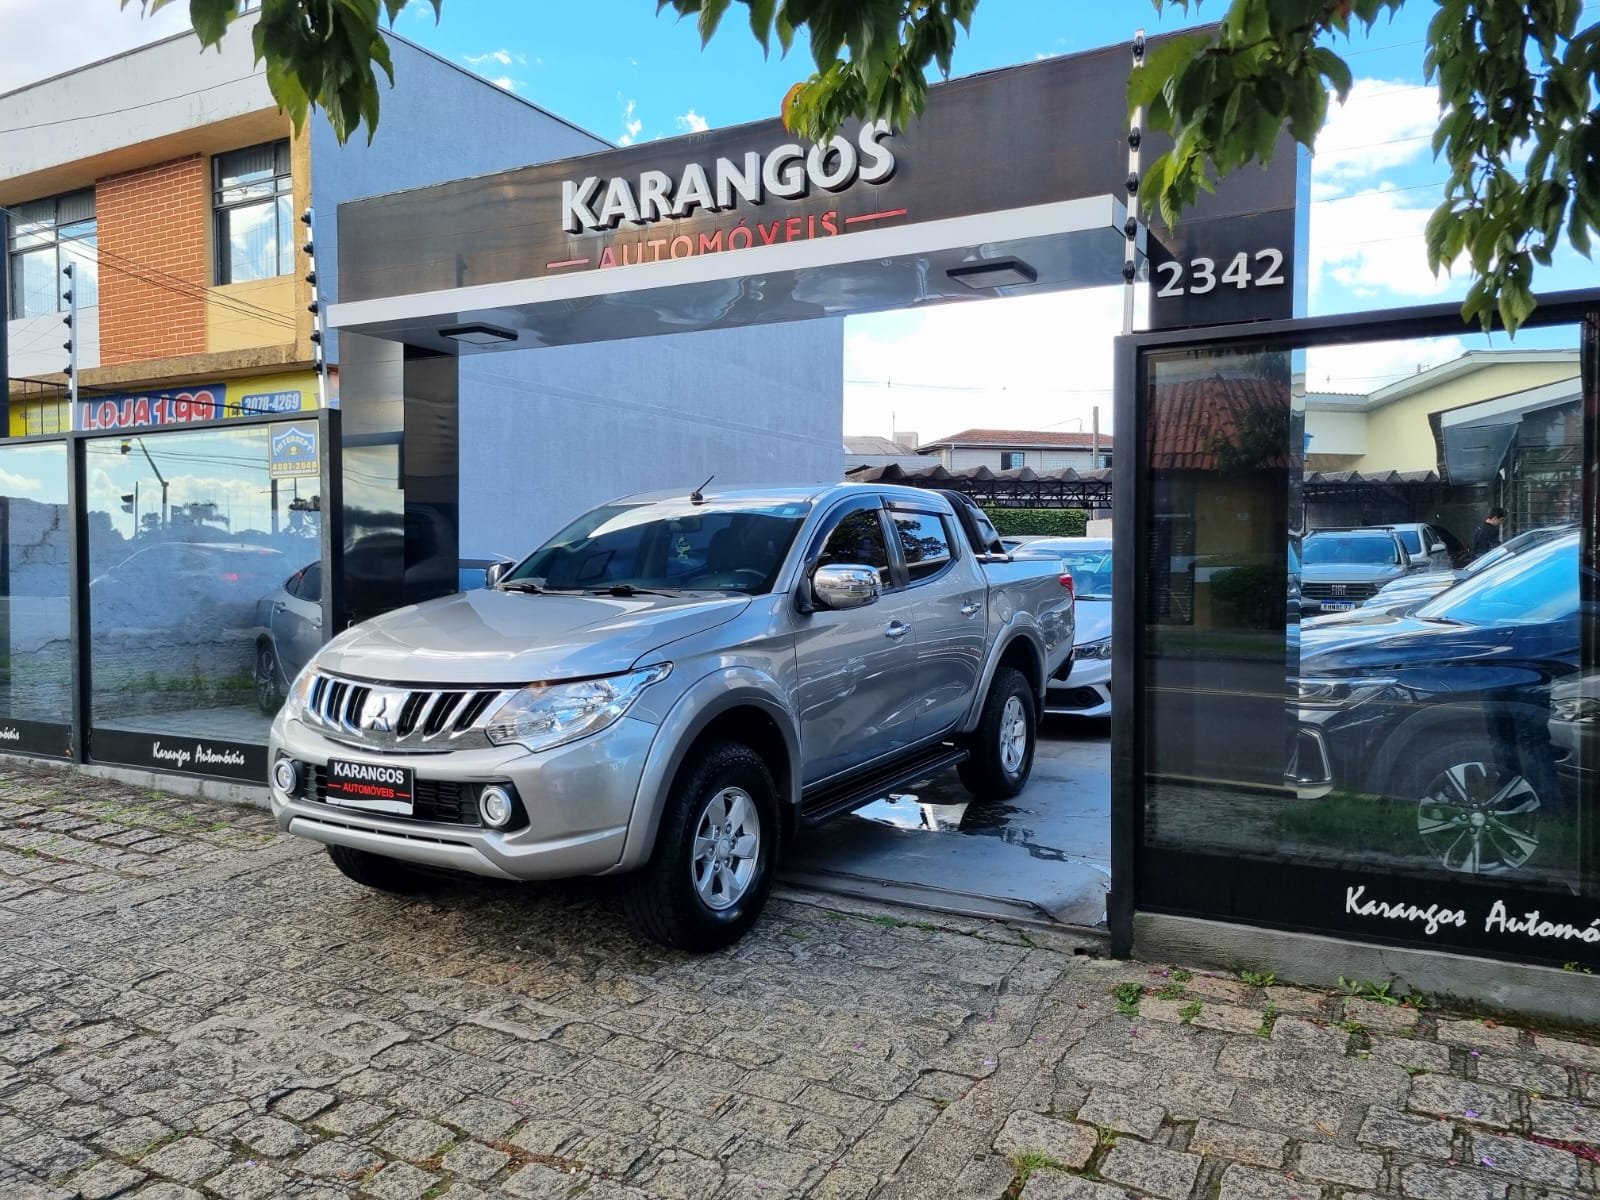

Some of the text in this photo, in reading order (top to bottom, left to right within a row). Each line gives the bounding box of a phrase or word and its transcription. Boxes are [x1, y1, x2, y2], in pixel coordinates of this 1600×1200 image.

[562, 118, 898, 234] KARANGOS
[598, 210, 838, 269] AUTOMÓVEIS
[1156, 248, 1285, 298] 2342
[82, 397, 152, 431] LOJA
[243, 393, 299, 414] 3078-4269
[1331, 584, 1347, 596] FIAT
[153, 741, 245, 767] Karangos Automóveis
[333, 762, 404, 784] KARANGOS
[343, 782, 394, 798] AUTOMÓVEIS
[1345, 885, 1467, 935] Karangos
